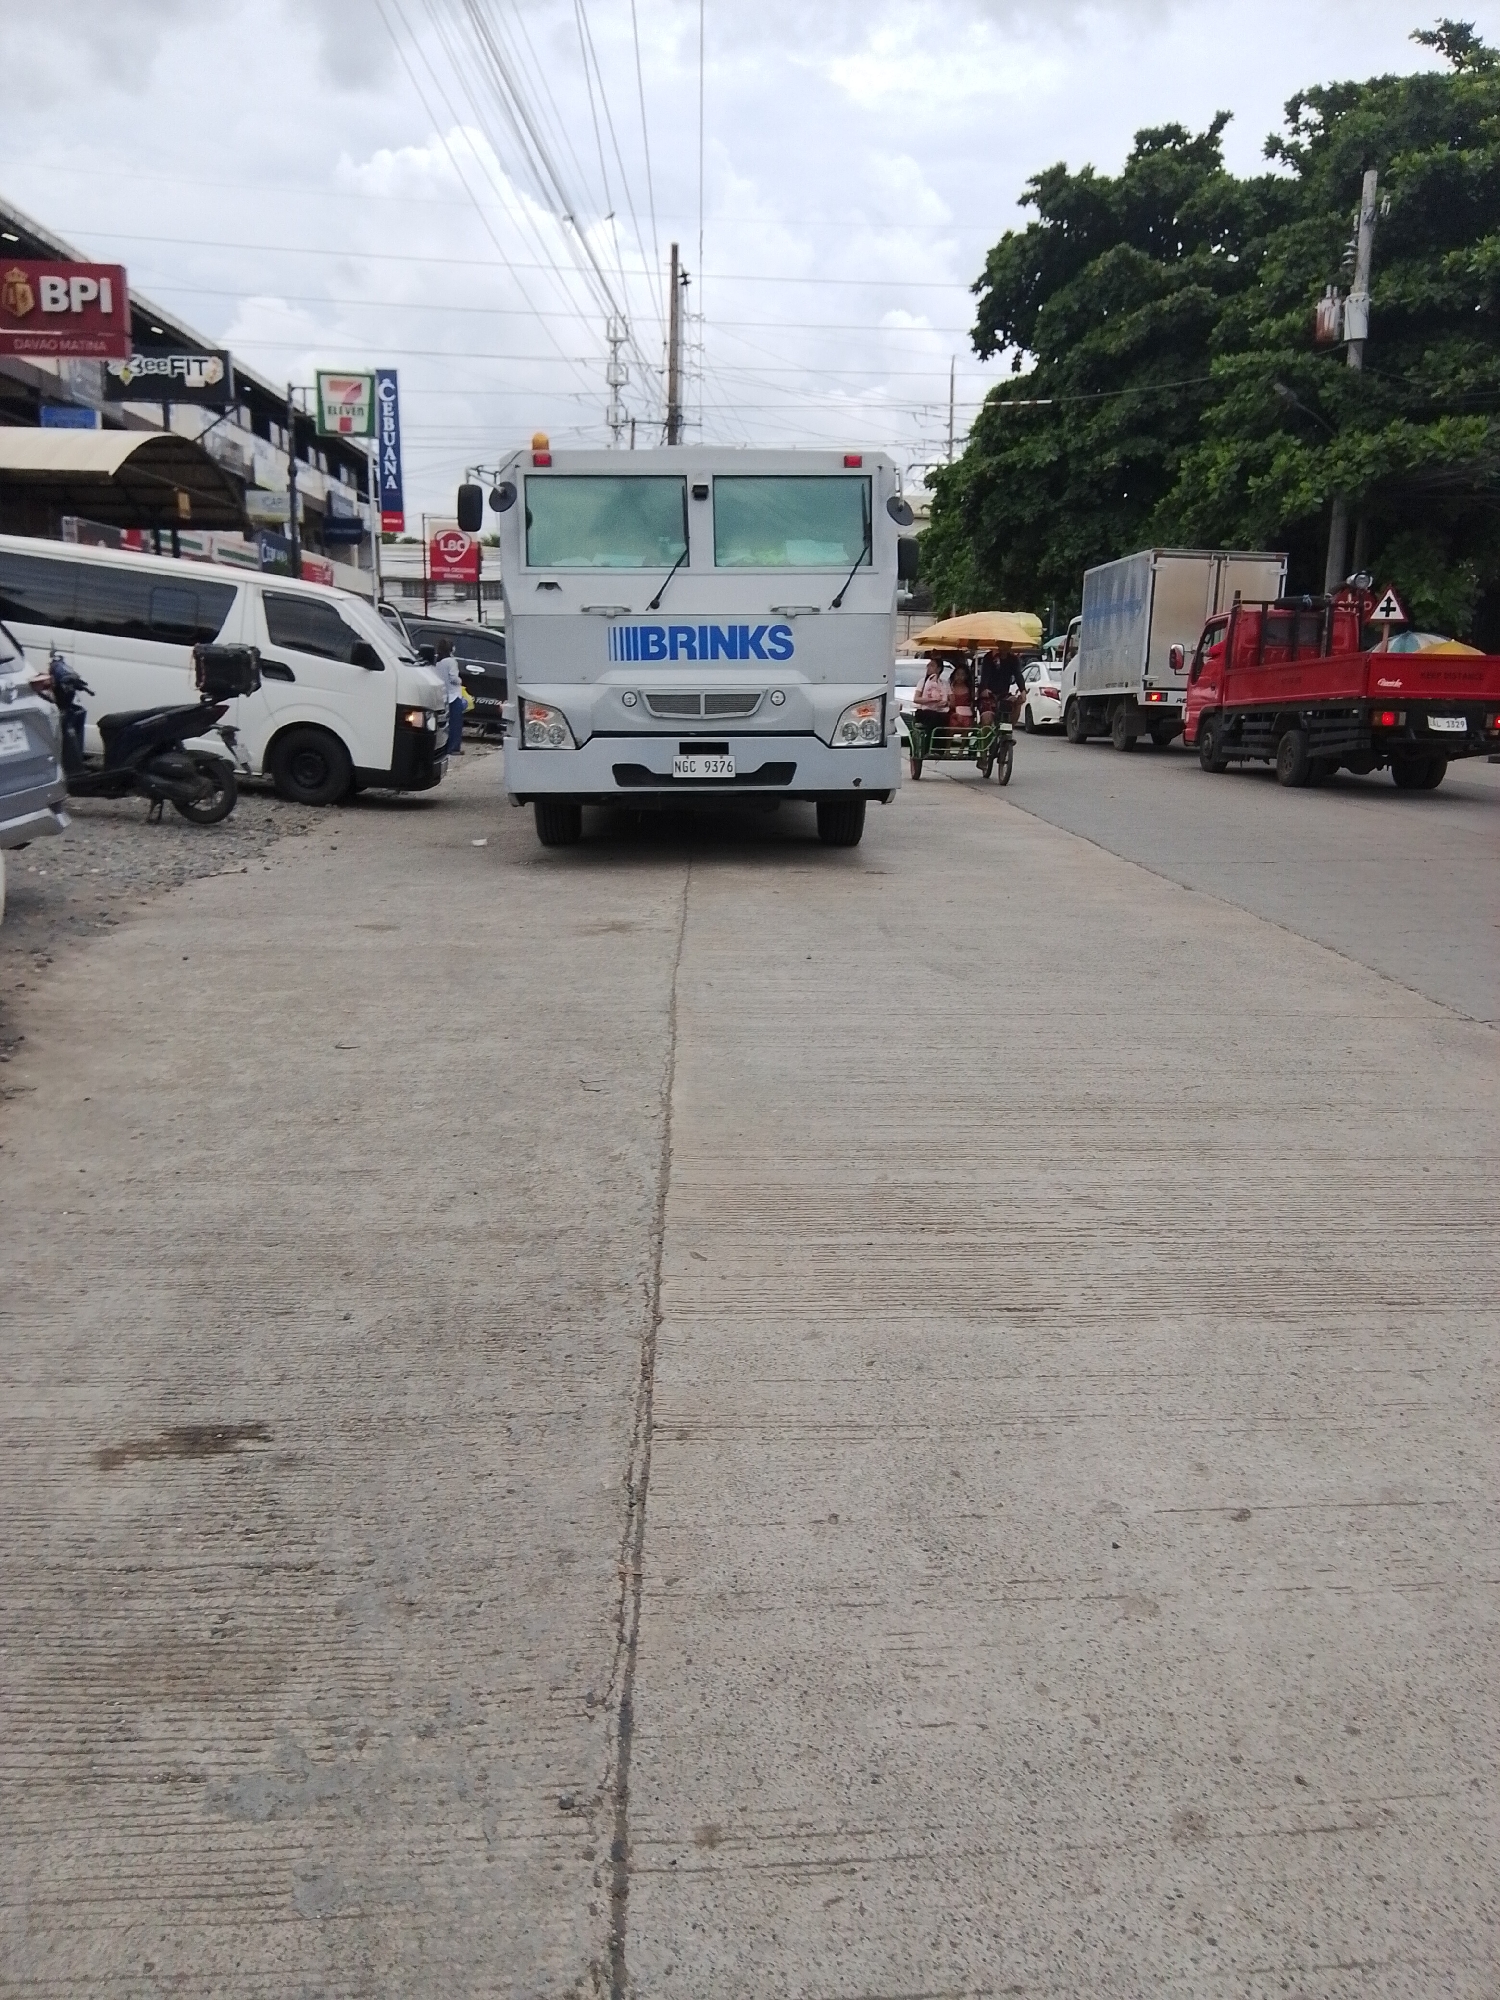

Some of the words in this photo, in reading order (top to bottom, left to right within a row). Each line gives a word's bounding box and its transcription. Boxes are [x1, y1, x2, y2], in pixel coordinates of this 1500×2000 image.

[39, 275, 113, 313] BPI
[13, 339, 58, 350] DAVAO
[59, 340, 107, 351] MATINA
[378, 378, 398, 490] CEBUANA
[440, 539, 466, 551] LBC
[640, 624, 795, 661] BRINKS
[475, 697, 502, 705] TOYOTA
[1446, 720, 1465, 728] 1329
[674, 761, 697, 773] NGC
[704, 761, 734, 773] 9376
